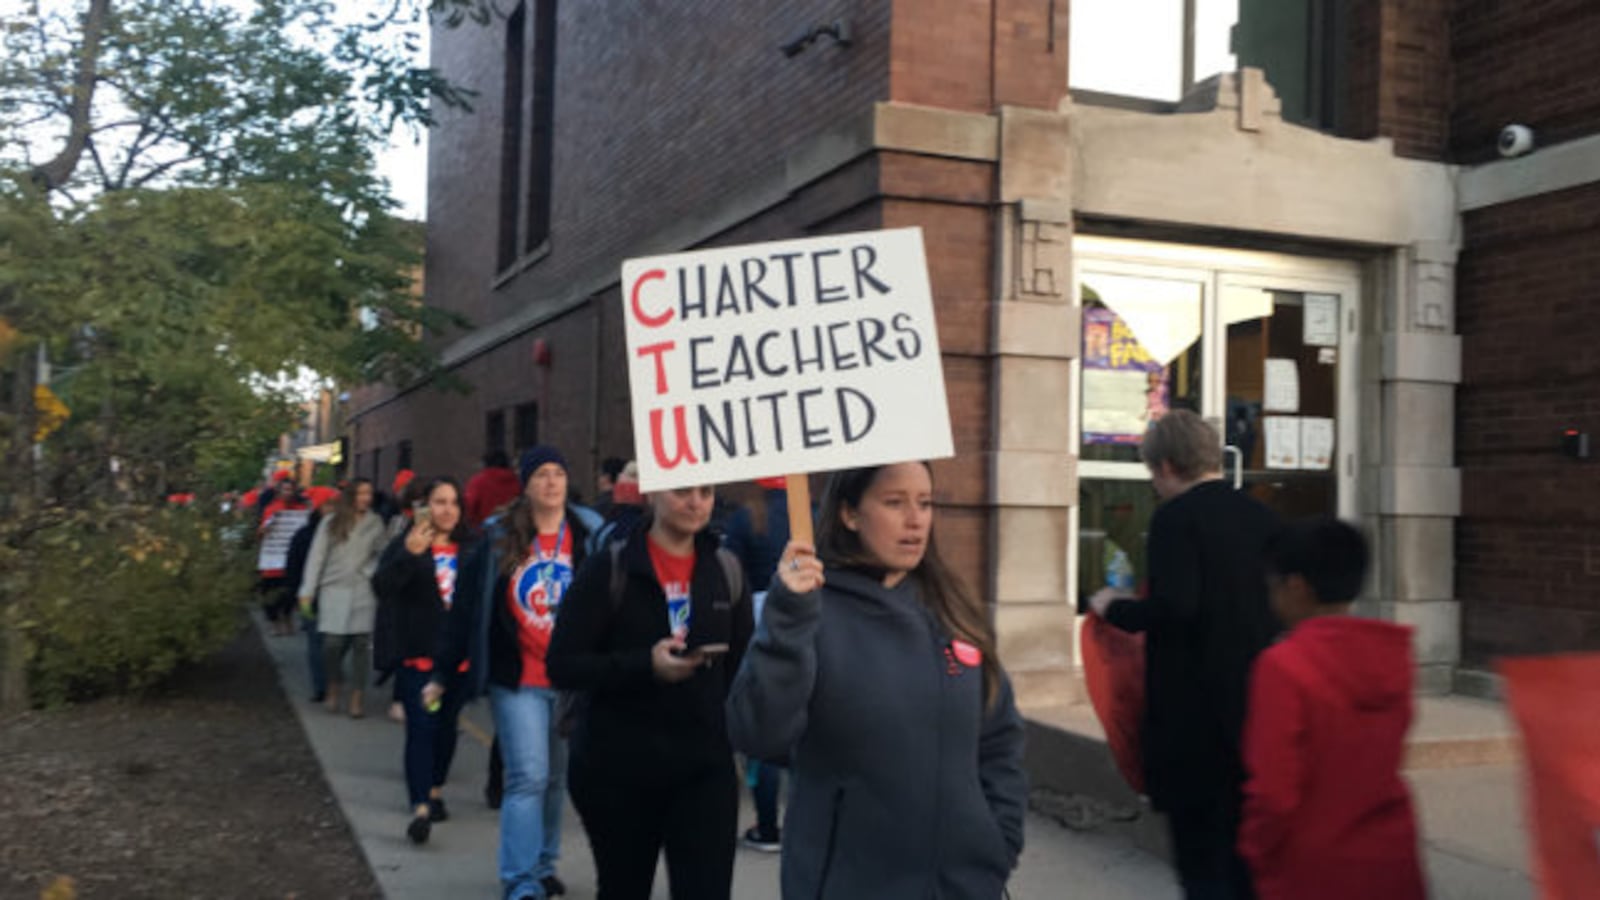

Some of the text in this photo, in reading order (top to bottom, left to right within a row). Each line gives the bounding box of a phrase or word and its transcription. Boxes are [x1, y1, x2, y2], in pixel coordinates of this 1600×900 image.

[631, 245, 891, 328] CHARTER
[637, 313, 922, 395] TEACHERS
[649, 388, 876, 469] UNITED
